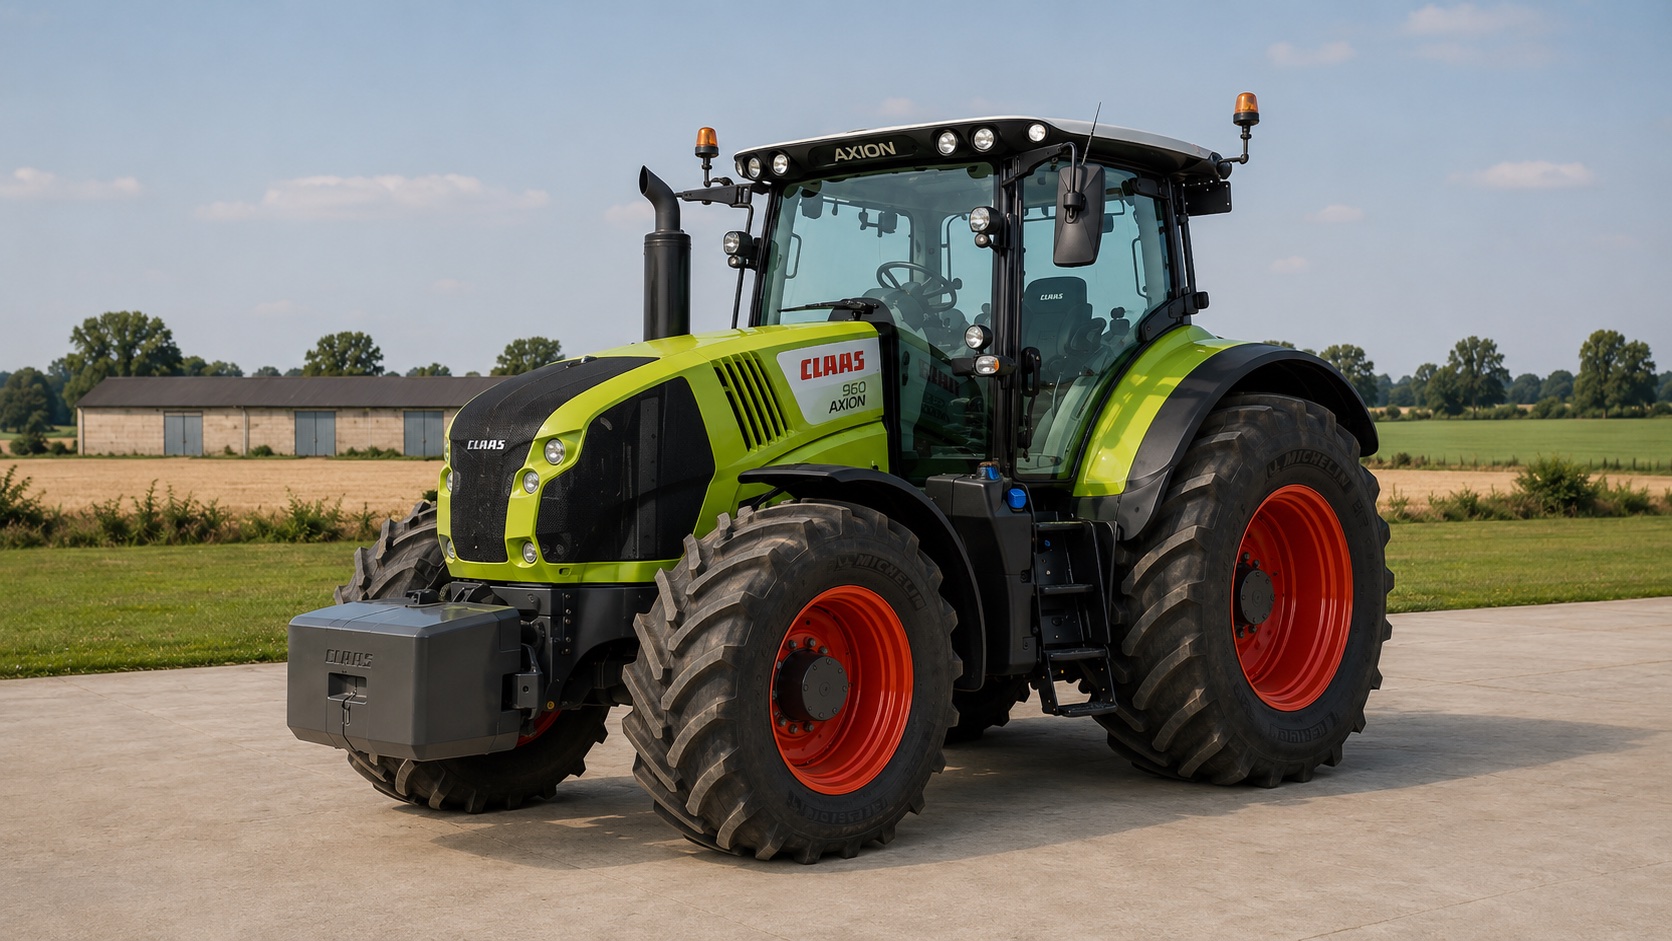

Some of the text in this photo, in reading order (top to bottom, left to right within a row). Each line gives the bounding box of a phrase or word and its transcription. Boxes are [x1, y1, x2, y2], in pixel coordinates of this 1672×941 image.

[834, 141, 897, 162] AXION
[1040, 293, 1064, 301] CLAAS
[800, 350, 865, 381] CLAAS
[842, 381, 867, 397] 960
[828, 395, 866, 414] AXION
[466, 439, 506, 450] CLAAS
[1283, 450, 1351, 488] MICHELIN
[325, 648, 373, 669] CLAAS
